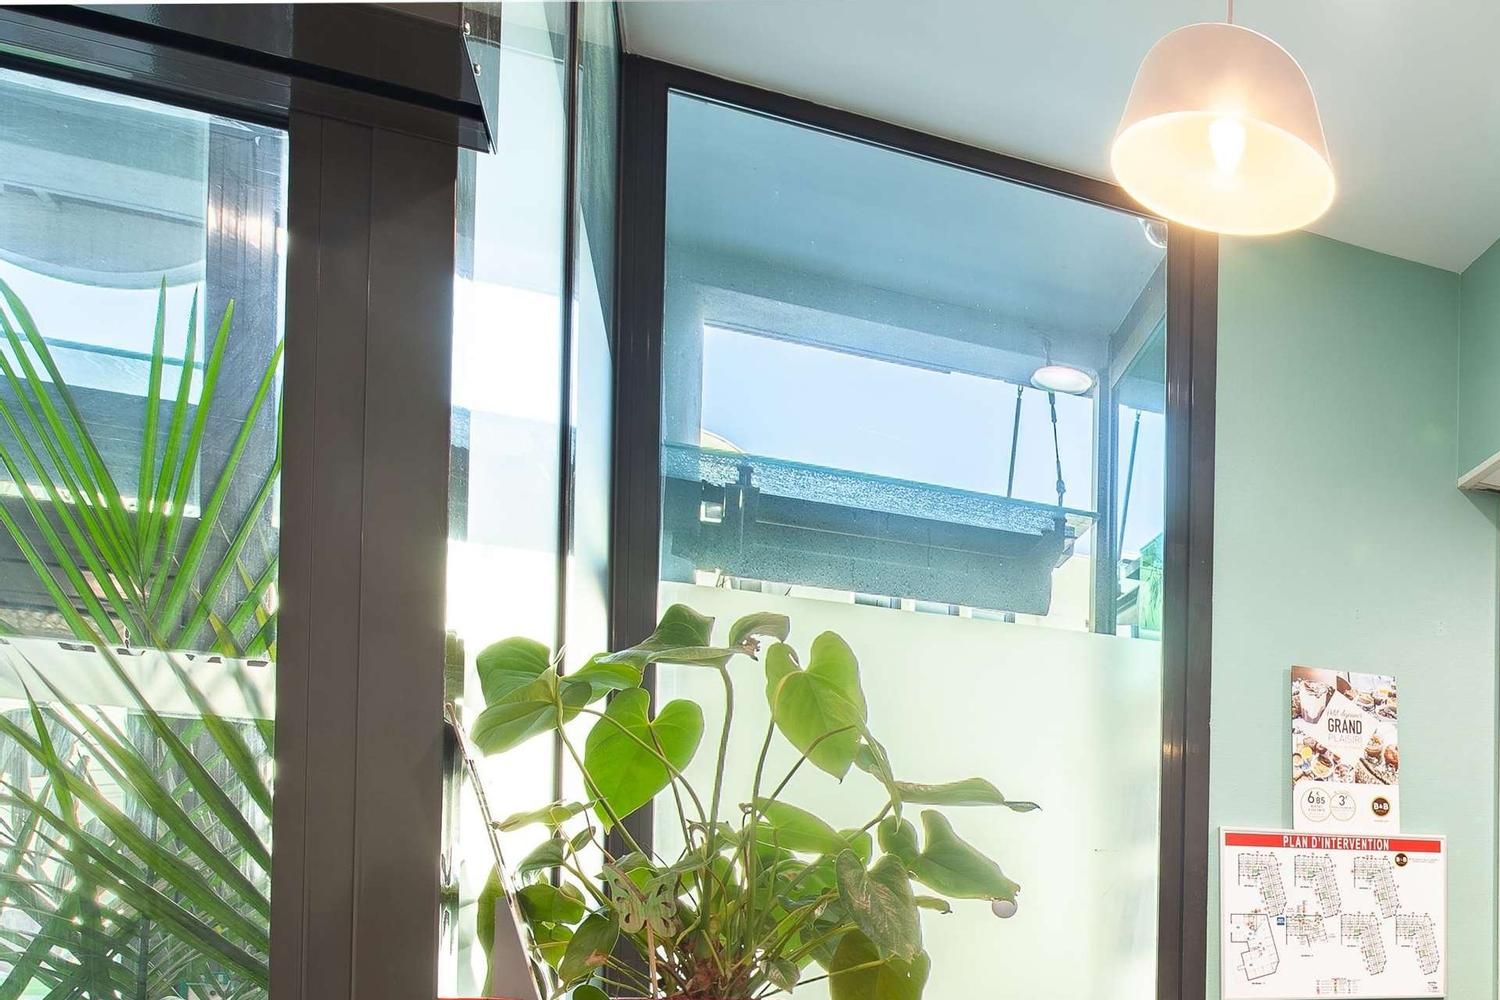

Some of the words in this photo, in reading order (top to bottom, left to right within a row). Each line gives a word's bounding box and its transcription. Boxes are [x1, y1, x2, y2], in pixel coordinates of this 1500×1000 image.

[1328, 718, 1362, 735] GRAND
[1283, 835, 1308, 848] PLAN
[1311, 836, 1390, 851] D'INTERVENTION
